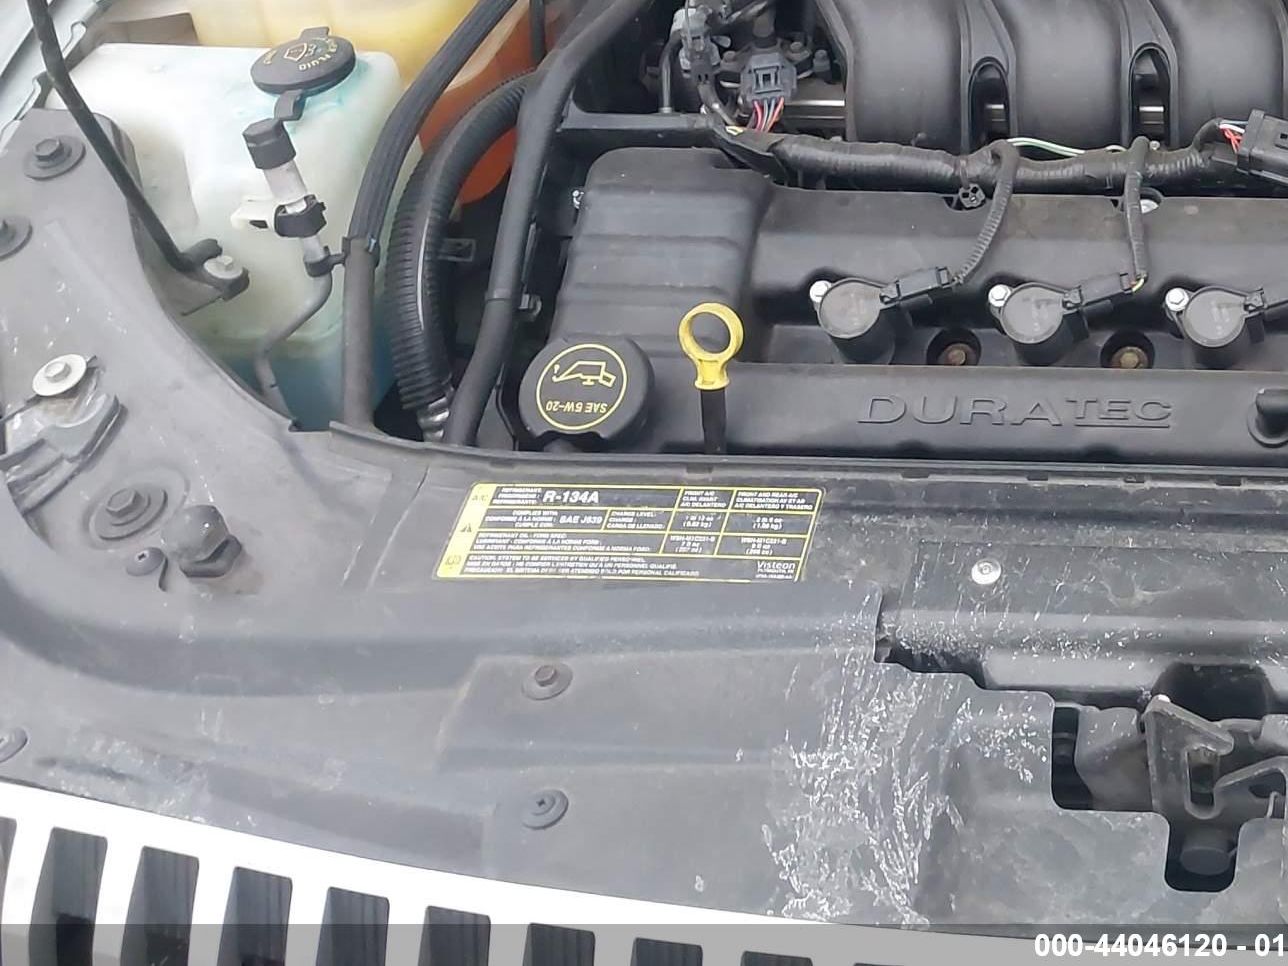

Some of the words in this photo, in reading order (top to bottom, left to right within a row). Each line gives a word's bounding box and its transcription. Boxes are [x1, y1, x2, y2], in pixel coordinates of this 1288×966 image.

[546, 400, 583, 413] 5W-20
[585, 401, 608, 414] SAE
[857, 394, 1172, 427] DURATEC
[542, 490, 600, 504] R-134A
[757, 560, 796, 570] Visteon
